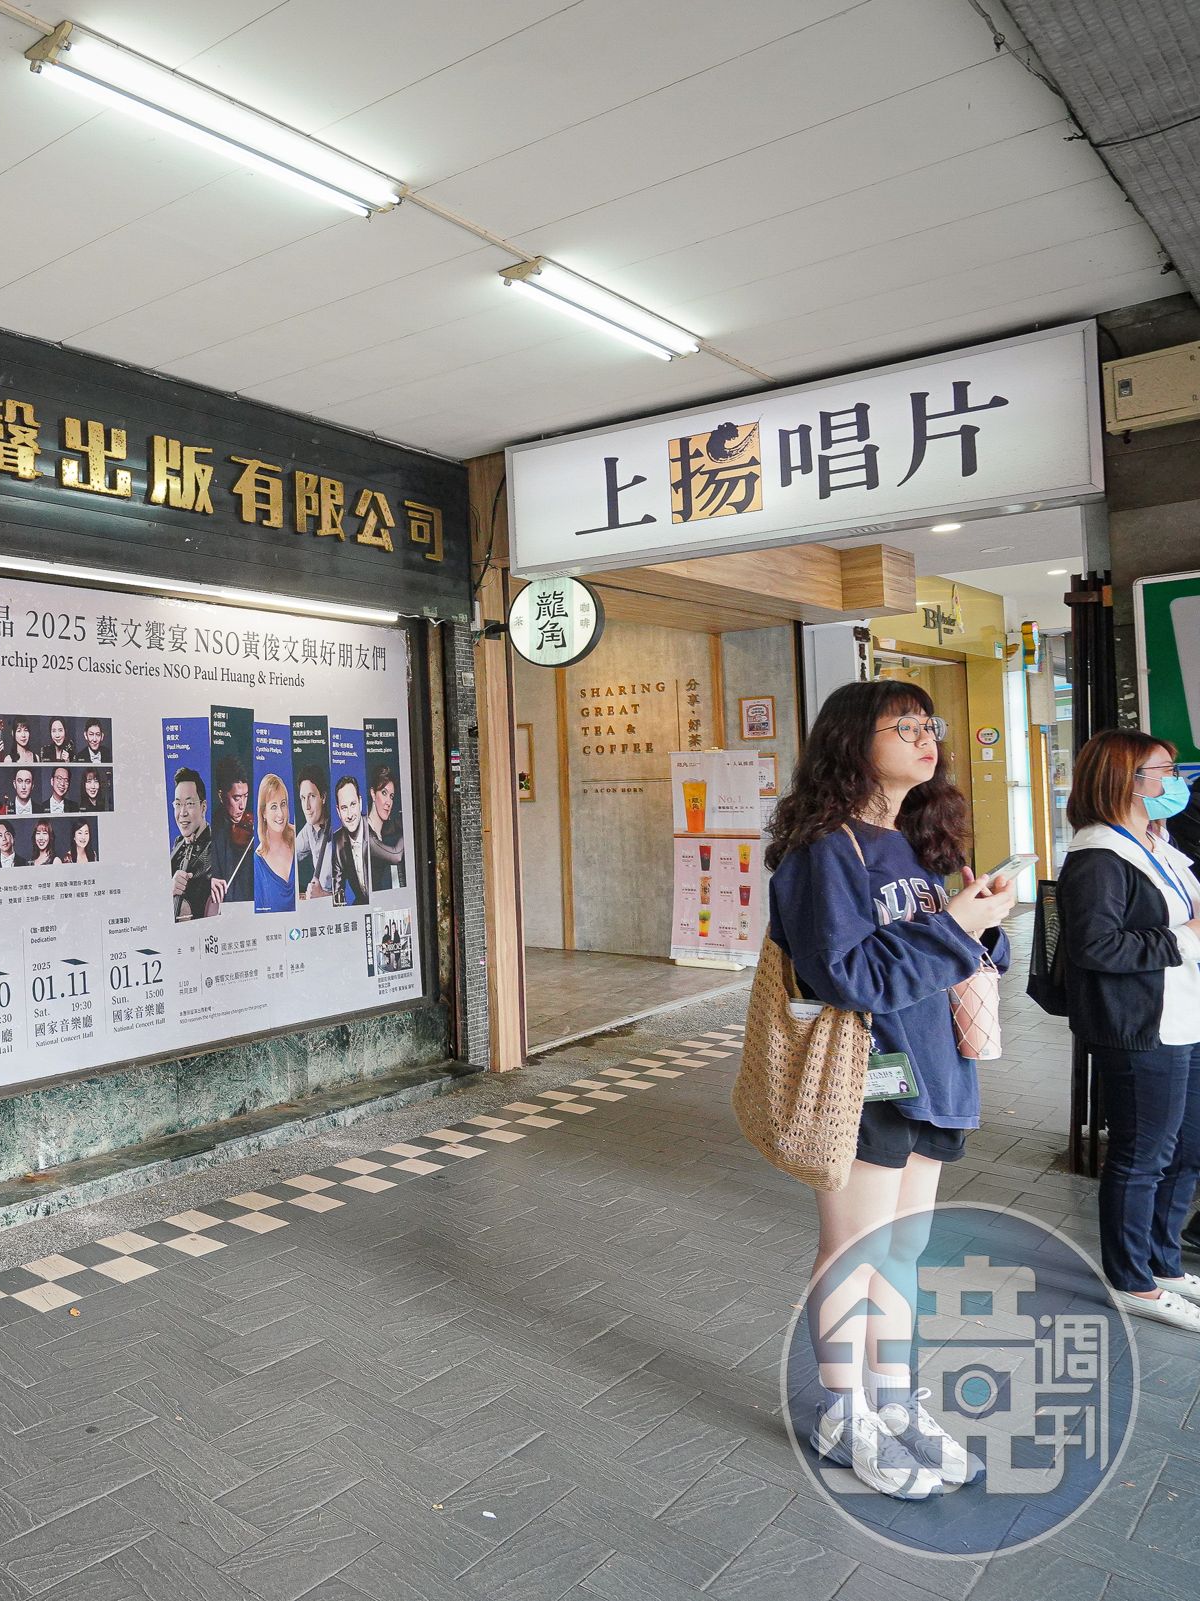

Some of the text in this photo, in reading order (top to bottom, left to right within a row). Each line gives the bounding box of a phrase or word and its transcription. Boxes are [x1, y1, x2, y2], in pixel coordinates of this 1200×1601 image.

[575, 381, 1009, 536] 上揚唱片
[535, 590, 569, 651] 龍角
[25, 610, 87, 642] 2025
[95, 615, 188, 654] 藝文饗宴
[41, 654, 75, 671] 2025
[77, 657, 123, 676] Classic
[124, 660, 160, 677] Series
[163, 663, 191, 680] NSO
[193, 665, 218, 682] Paul
[220, 667, 256, 688] Huang
[257, 671, 267, 685] &
[269, 671, 305, 688] Friends
[580, 682, 666, 698] SHARING
[580, 703, 640, 718] GREAT
[581, 723, 636, 737] TEA &
[582, 742, 654, 756] COFFEE
[108, 925, 148, 935] Romantic Twilight
[30, 936, 57, 944] Dedication
[109, 951, 127, 961] 2025
[32, 961, 51, 971] 2025
[109, 960, 163, 991] 01.12
[32, 970, 91, 1003] 01.11
[111, 988, 164, 1005] Sun. 15:00
[34, 1000, 92, 1019] Sat. 19:30
[112, 1002, 165, 1024] 國家音樂廳
[34, 1014, 93, 1037] 國家音樂廳
[113, 1017, 166, 1033] National Concert Hall
[35, 1031, 94, 1048] National Concert Hall
